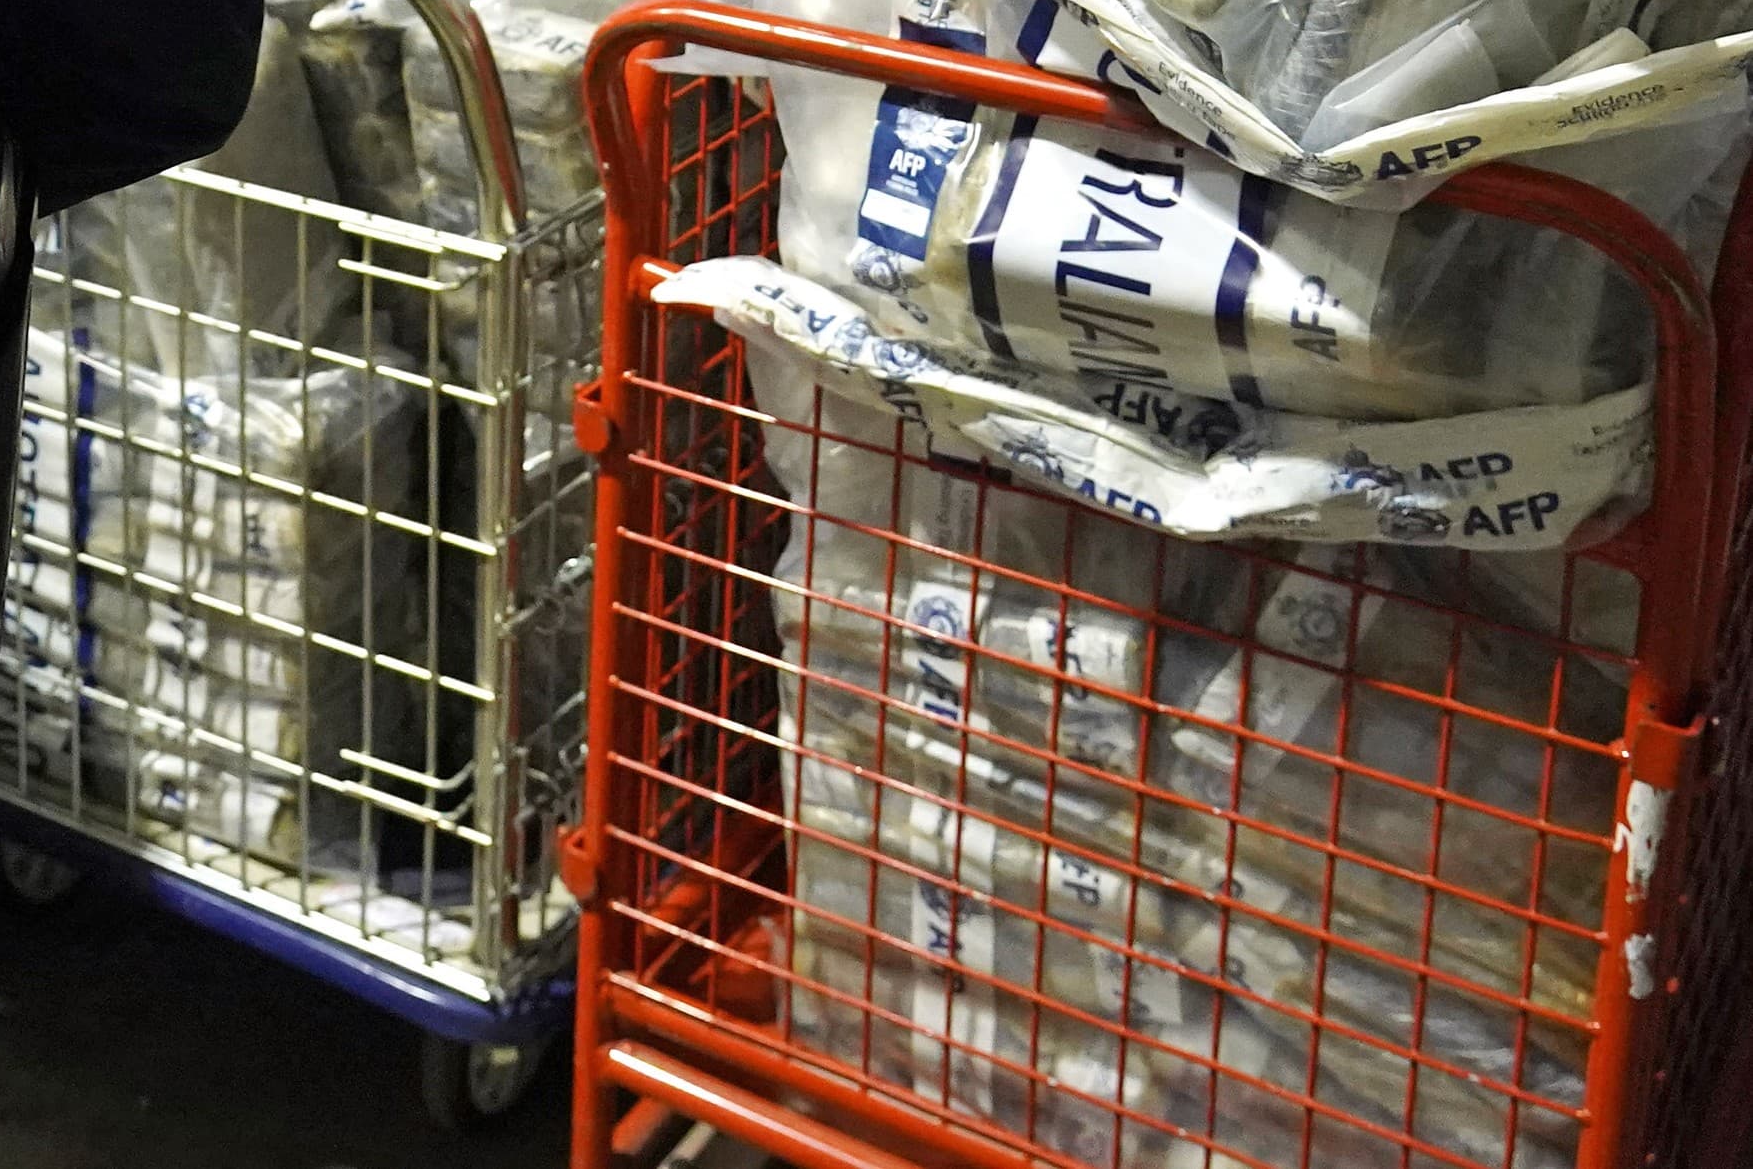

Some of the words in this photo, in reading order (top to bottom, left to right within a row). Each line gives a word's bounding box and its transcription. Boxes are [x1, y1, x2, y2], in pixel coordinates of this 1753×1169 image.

[1157, 60, 1223, 118] Evidence
[1571, 83, 1666, 115] Evidence
[888, 149, 927, 178] AFP
[1376, 134, 1483, 181] AFP
[753, 284, 837, 335] AFP
[1290, 274, 1341, 363] AFP
[1095, 382, 1184, 436] AFP
[1462, 490, 1561, 538] AFP
